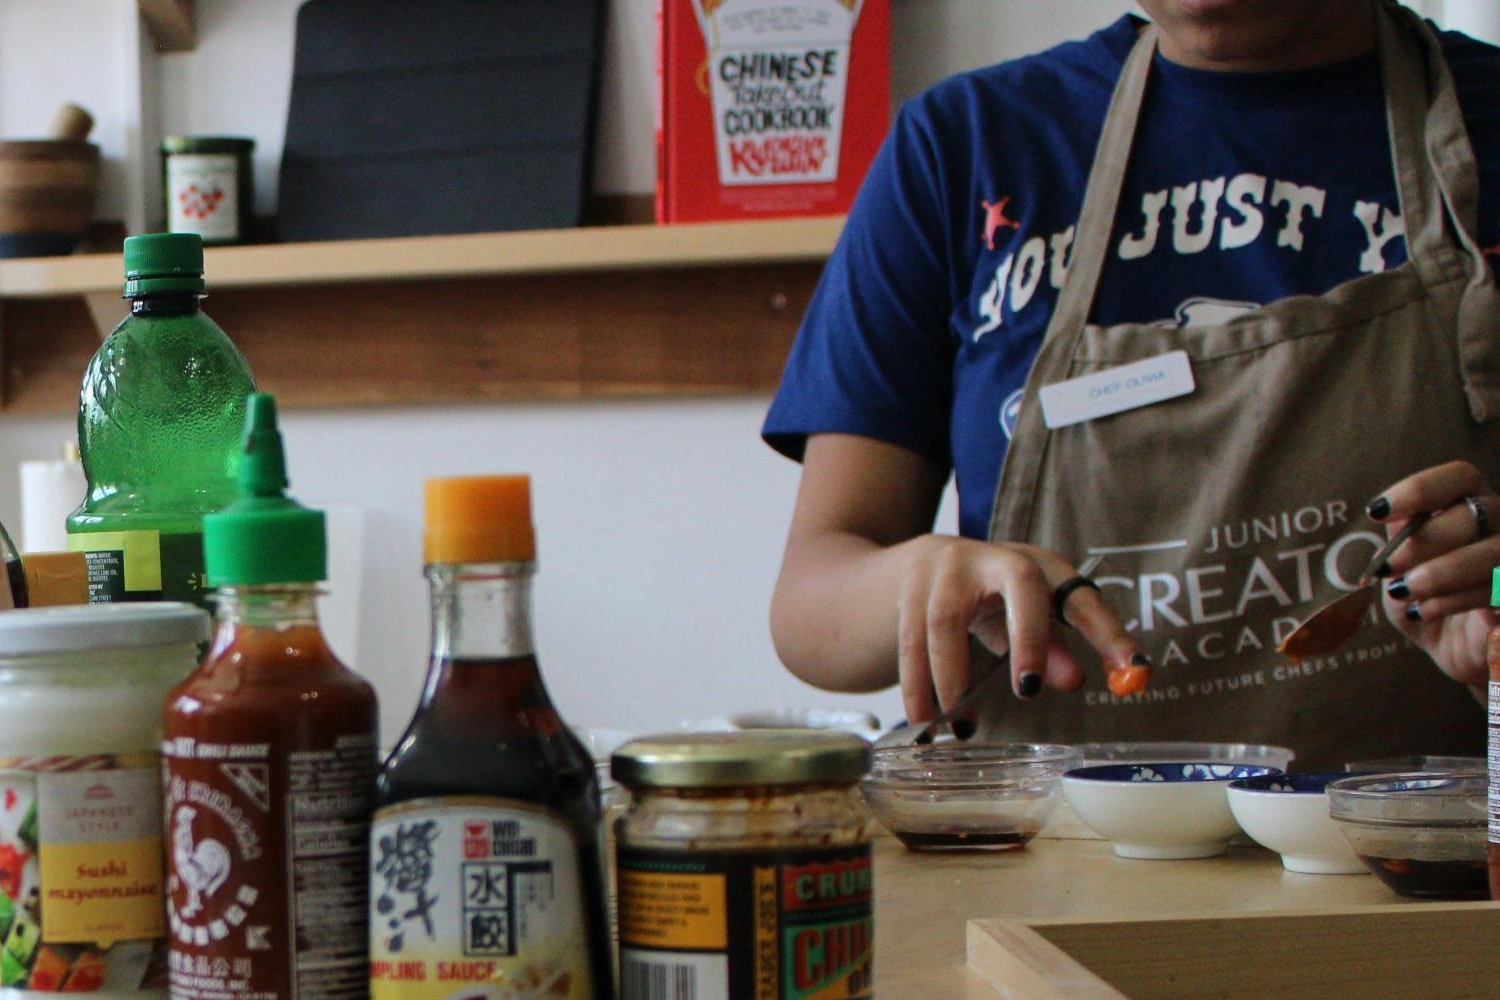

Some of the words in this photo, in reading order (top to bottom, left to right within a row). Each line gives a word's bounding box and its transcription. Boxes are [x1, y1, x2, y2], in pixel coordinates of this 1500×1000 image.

[720, 51, 837, 83] CHINESE
[724, 105, 834, 136] COOKBOOK
[974, 225, 1074, 343] YOU
[1118, 173, 1326, 260] JUST
[1089, 379, 1121, 399] CHEF
[1205, 500, 1348, 553] JUNIOR
[1188, 669, 1266, 699] FUTURE
[1273, 655, 1340, 683] CHEFS
[76, 861, 127, 880] Sushi
[48, 882, 156, 904] mayonnaise
[437, 960, 498, 982] SAUCE
